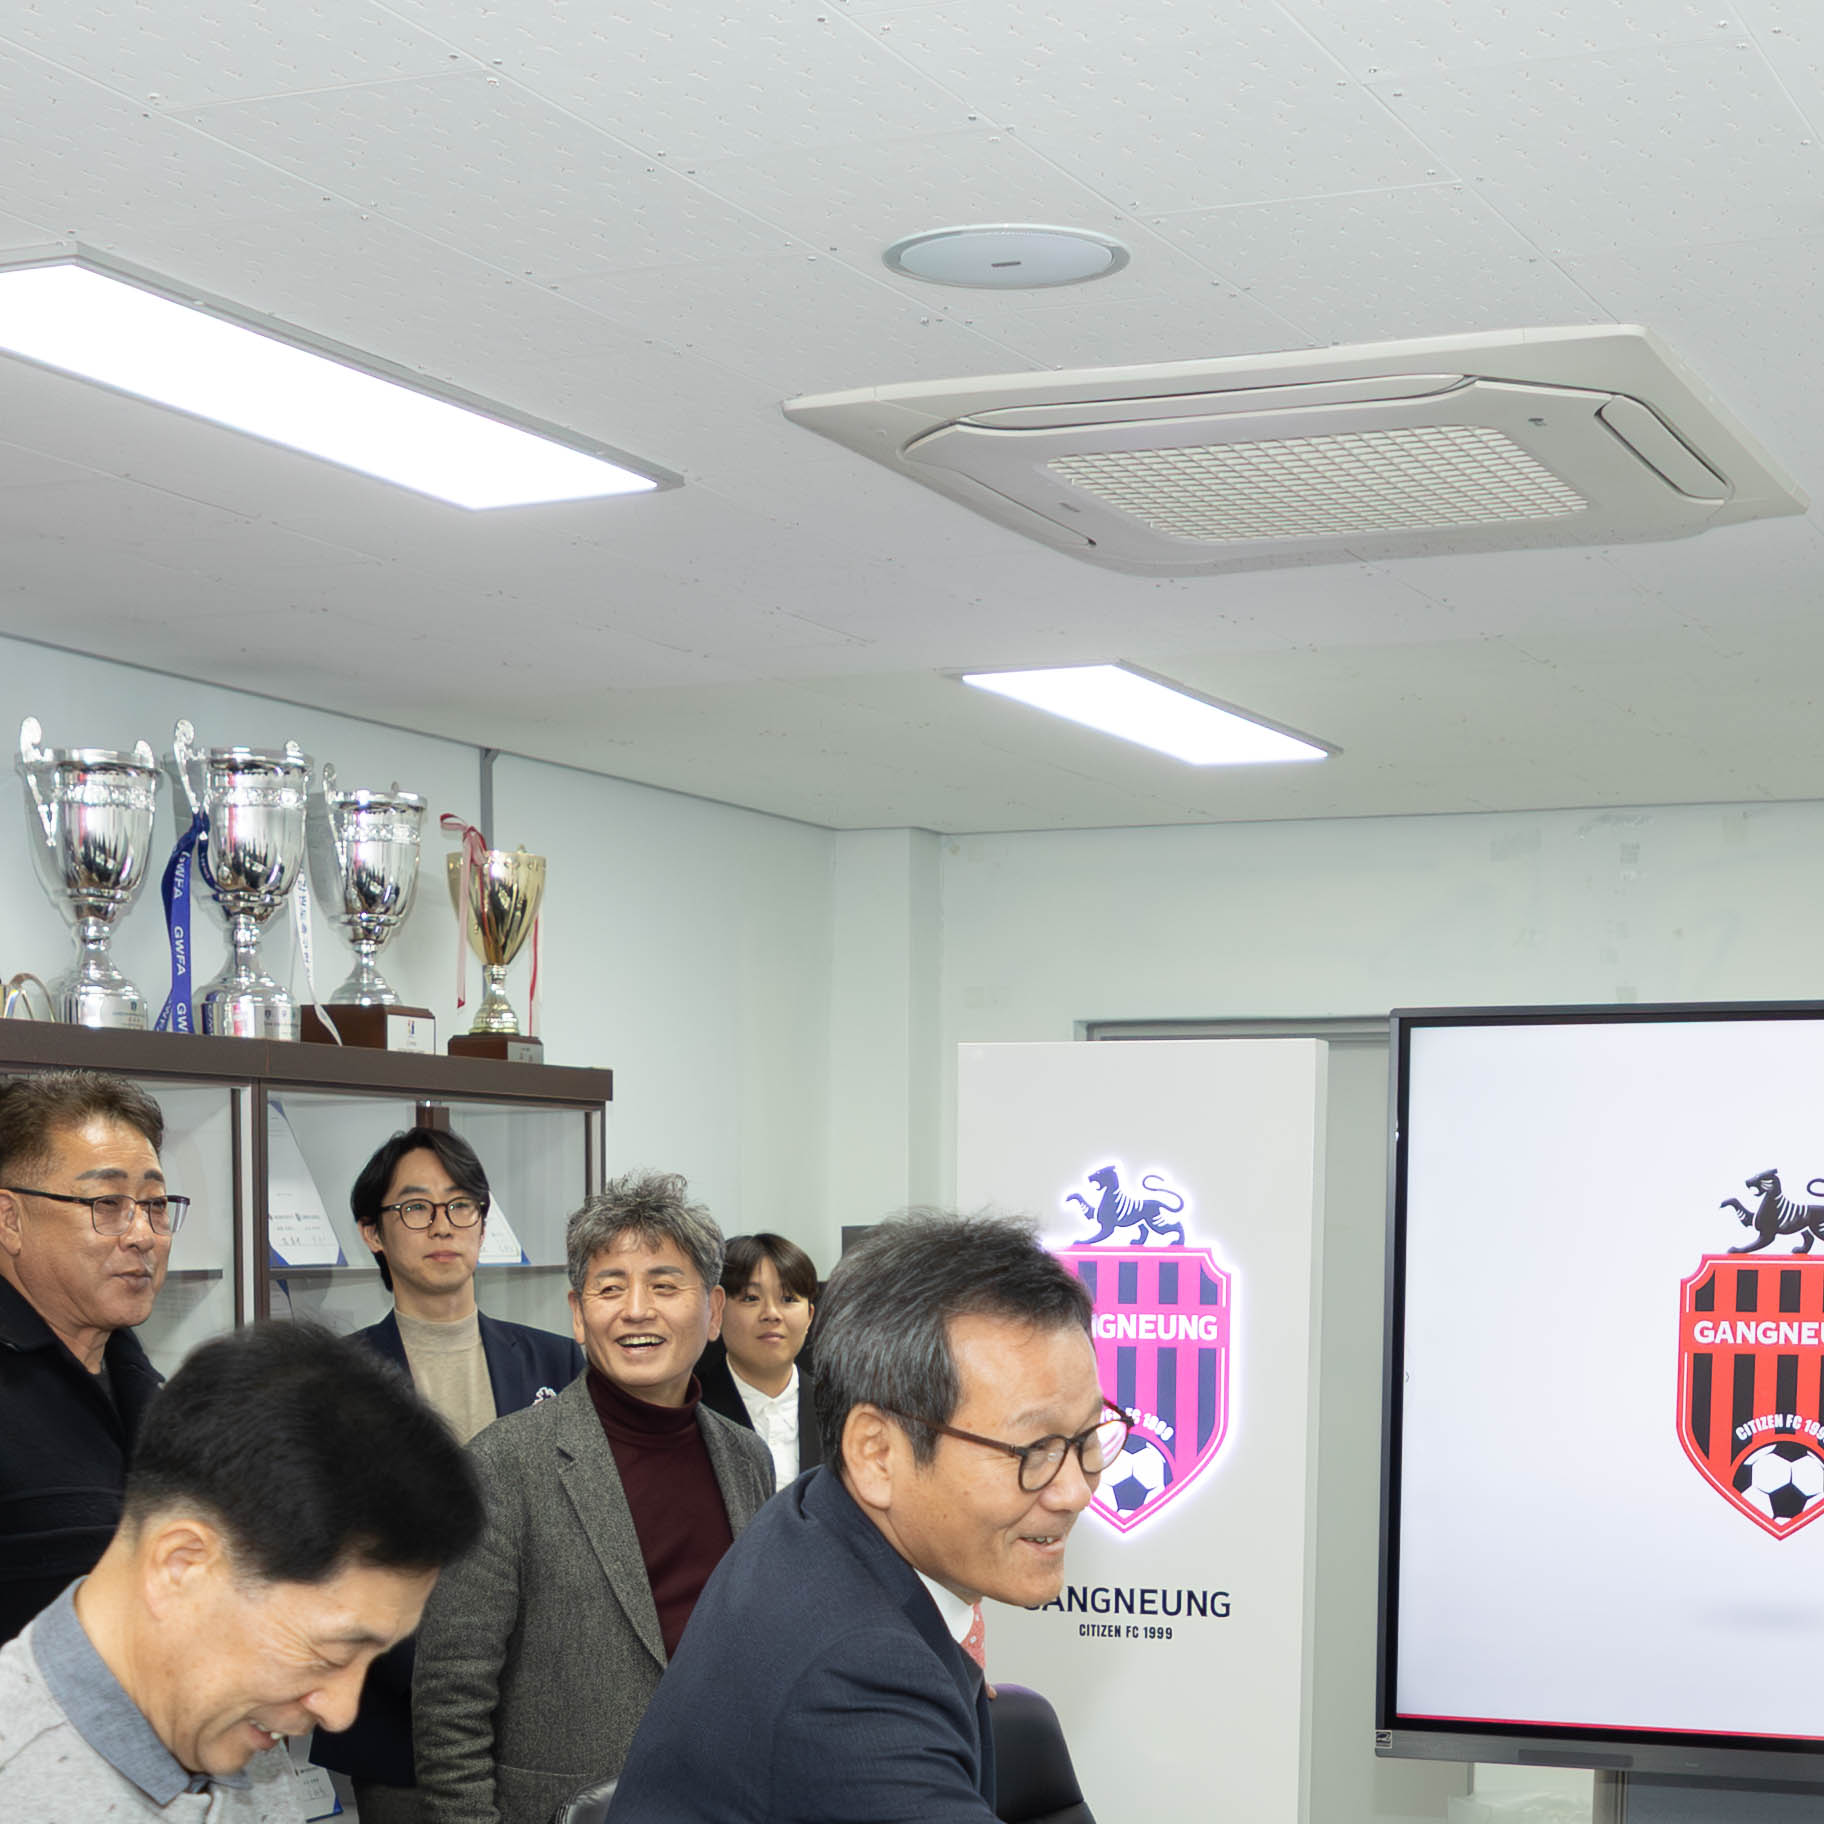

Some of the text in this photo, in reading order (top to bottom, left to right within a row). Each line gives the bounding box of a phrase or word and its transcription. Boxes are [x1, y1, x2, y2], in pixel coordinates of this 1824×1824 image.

[173, 850, 190, 1034] GWFA GWFA GW
[1090, 1312, 1219, 1342] GNEUNG
[1735, 1413, 1784, 1441] CITIZEN
[1785, 1414, 1803, 1430] FC
[1079, 1623, 1173, 1640] CITIZEN FC 1999
